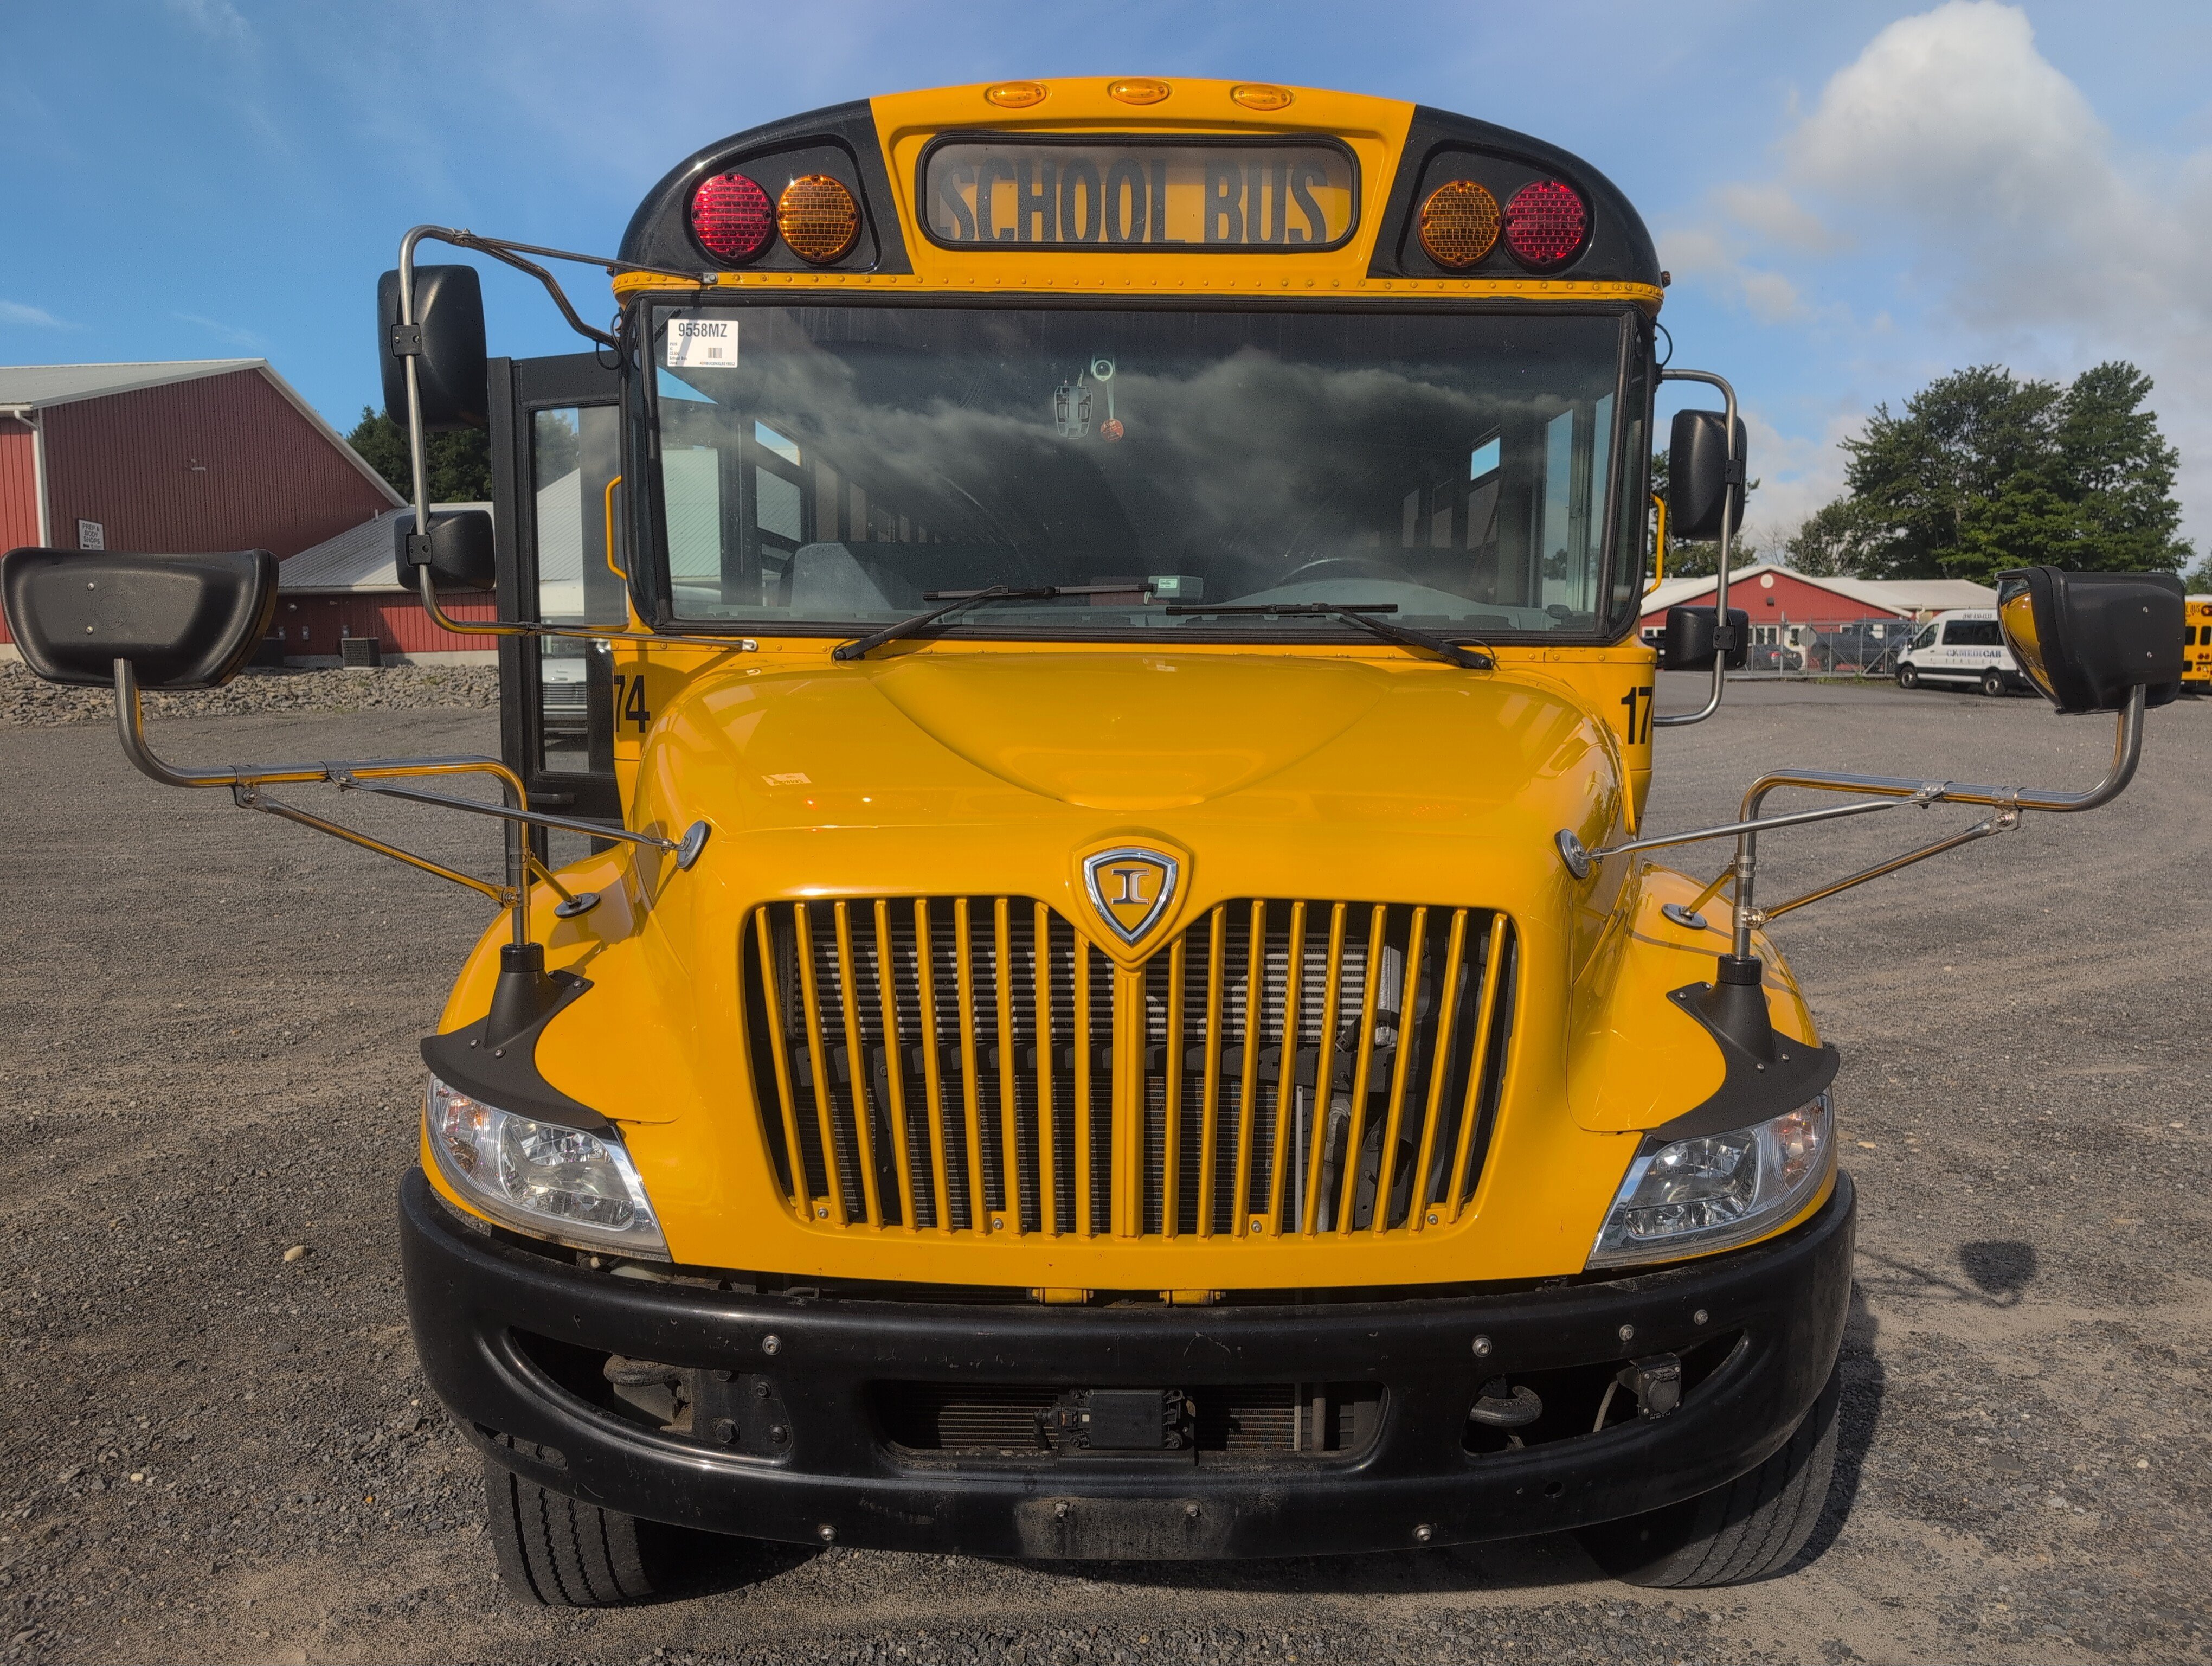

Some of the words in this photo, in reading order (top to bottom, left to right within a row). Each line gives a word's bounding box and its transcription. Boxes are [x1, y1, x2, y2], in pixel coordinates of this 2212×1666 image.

[937, 158, 1186, 243] SCHOOL
[1204, 162, 1328, 244] BUS
[678, 323, 728, 337] 9558MZ
[83, 536, 100, 544] SHOPS
[1621, 687, 1654, 745] 17
